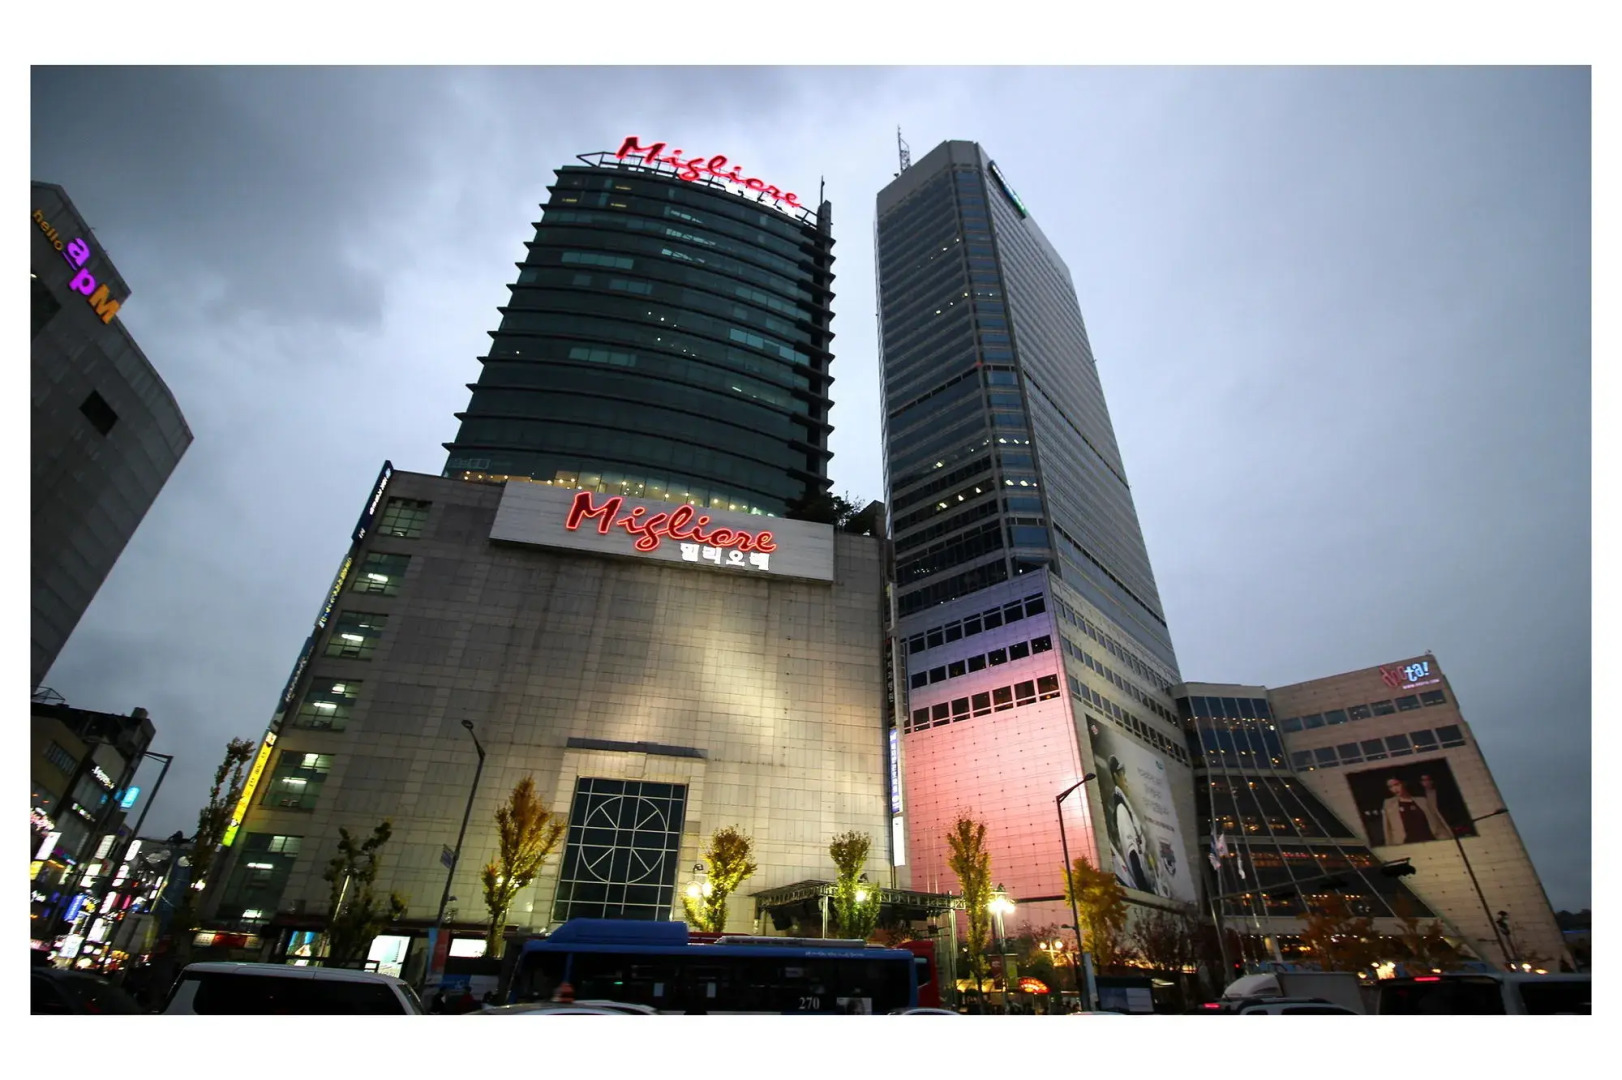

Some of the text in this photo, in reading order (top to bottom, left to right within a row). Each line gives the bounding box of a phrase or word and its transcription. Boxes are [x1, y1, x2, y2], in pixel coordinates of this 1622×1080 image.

[615, 136, 801, 207] Migliore
[33, 209, 64, 251] hello
[565, 491, 777, 551] Migliore
[798, 996, 820, 1010] 270
